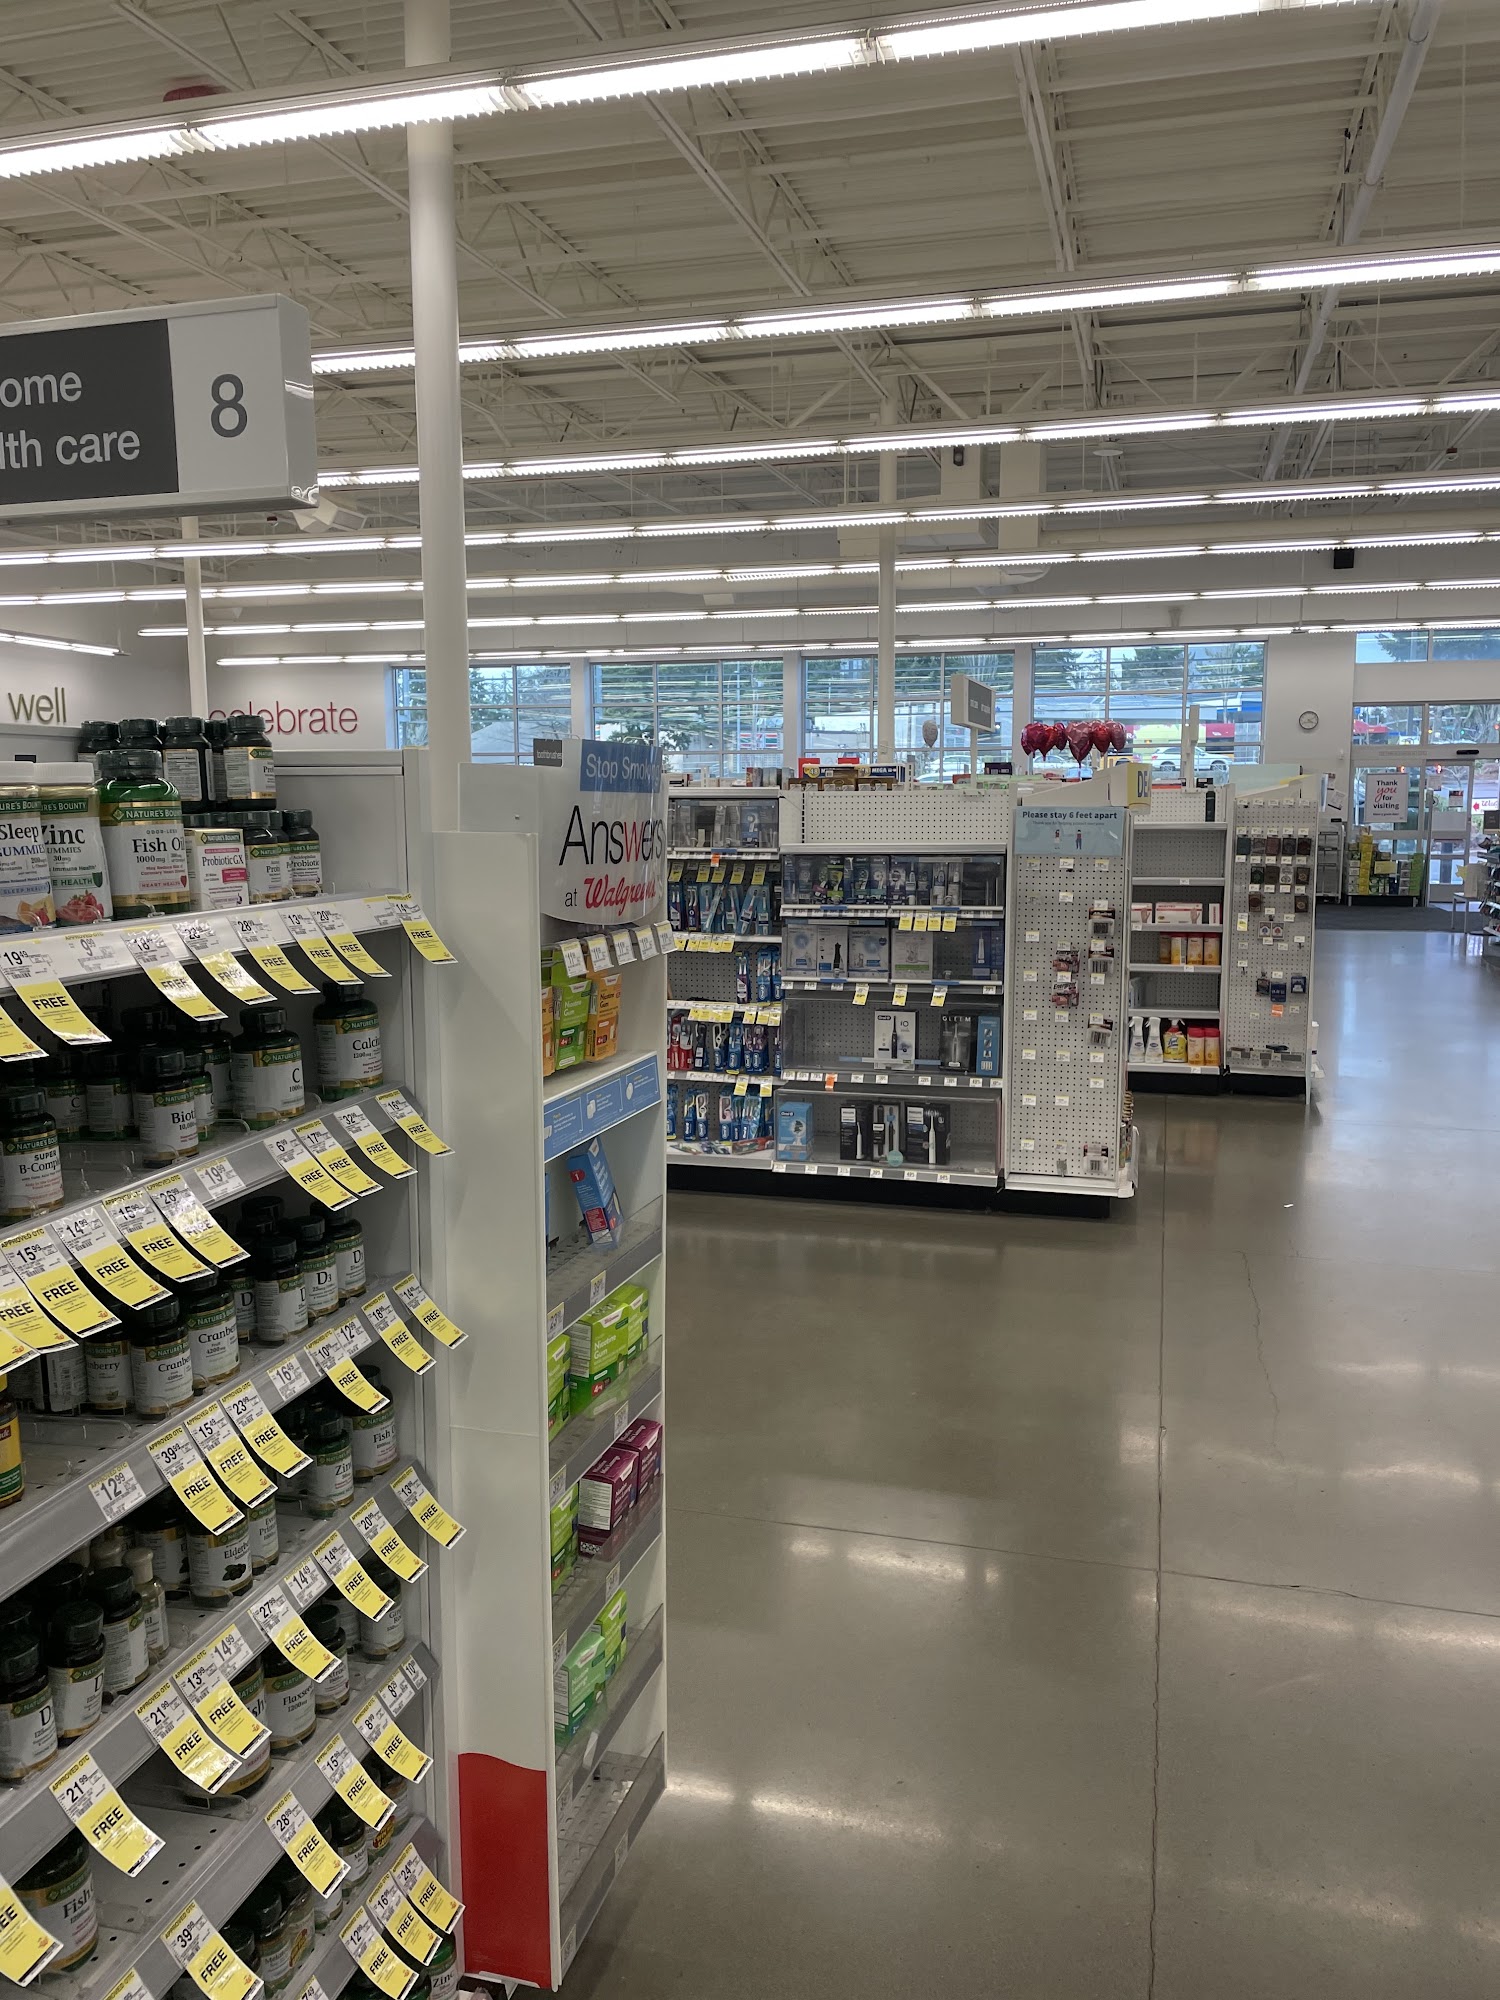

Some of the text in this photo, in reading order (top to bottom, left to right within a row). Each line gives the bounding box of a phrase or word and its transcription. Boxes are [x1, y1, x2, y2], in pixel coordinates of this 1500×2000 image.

[0, 372, 82, 404] ome
[209, 373, 249, 438] 8
[0, 428, 141, 469] lth care
[8, 687, 67, 724] well
[586, 753, 661, 787] Stop Smoking
[1375, 787, 1397, 802] you
[58, 802, 87, 811] BOUNTY
[125, 810, 164, 819] NATURE'S
[1022, 811, 1118, 822] Please stay 6 feet apart
[0, 823, 39, 843] Sleep
[559, 805, 665, 866] Answers
[131, 837, 167, 853] Fish
[564, 874, 656, 916] at Walgreens
[411, 929, 433, 940] FREE
[309, 949, 333, 960] FREE
[339, 943, 362, 954] FREE
[262, 956, 287, 968] FREE
[32, 995, 70, 1010] FREE
[352, 1036, 381, 1052] Calci
[70, 1097, 80, 1109] C
[408, 1124, 427, 1136] FREE
[33, 1152, 57, 1162] SUPER
[366, 1142, 388, 1156] FREE
[18, 1157, 60, 1175] B-Comp
[328, 1157, 351, 1172] FREE
[301, 1168, 324, 1186] FREE
[1, 1228, 45, 1249] APPROVED OTC
[142, 1237, 175, 1255] FREE
[96, 1258, 131, 1279] FREE
[42, 1280, 80, 1302] FREE
[0, 1301, 35, 1322] FREE
[422, 1310, 441, 1326] FREE
[198, 1322, 238, 1345] Cranber
[391, 1332, 410, 1349] FREE
[338, 1370, 359, 1388] FREE
[221, 1381, 252, 1403] APPROVED OTC
[186, 1402, 218, 1426] APPROVED OTC
[149, 1427, 183, 1452] APPROVED OTC
[254, 1426, 279, 1448] FREE
[373, 1427, 391, 1444] Fish
[219, 1451, 246, 1474] FREE
[183, 1475, 211, 1500] FREE
[420, 1503, 439, 1524] FREE
[313, 1540, 330, 1557] APPROVED
[380, 1536, 400, 1558] FREE
[344, 1572, 366, 1595] FREE
[284, 1628, 309, 1655] FREE
[174, 1649, 207, 1680] APPROVED OTC
[136, 1682, 171, 1716] APPROVED OTC
[282, 1685, 313, 1706] Flaxsee
[209, 1696, 237, 1726] FREE
[174, 1731, 202, 1761] FREE
[384, 1735, 403, 1760] FREE
[51, 1754, 90, 1792] APPROVED OTC
[346, 1774, 368, 1802] FREE
[266, 1791, 293, 1822] APPROVED OTC
[92, 1806, 124, 1841] FREE
[296, 1835, 321, 1863] FREE
[62, 1886, 91, 1919] Fish
[419, 1881, 437, 1908] FREE
[0, 1903, 18, 1933] EE
[165, 1902, 196, 1940] APPROVED OTC
[396, 1909, 415, 1939] FREE
[200, 1948, 228, 1983] FREE
[369, 1948, 389, 1976] FREE
